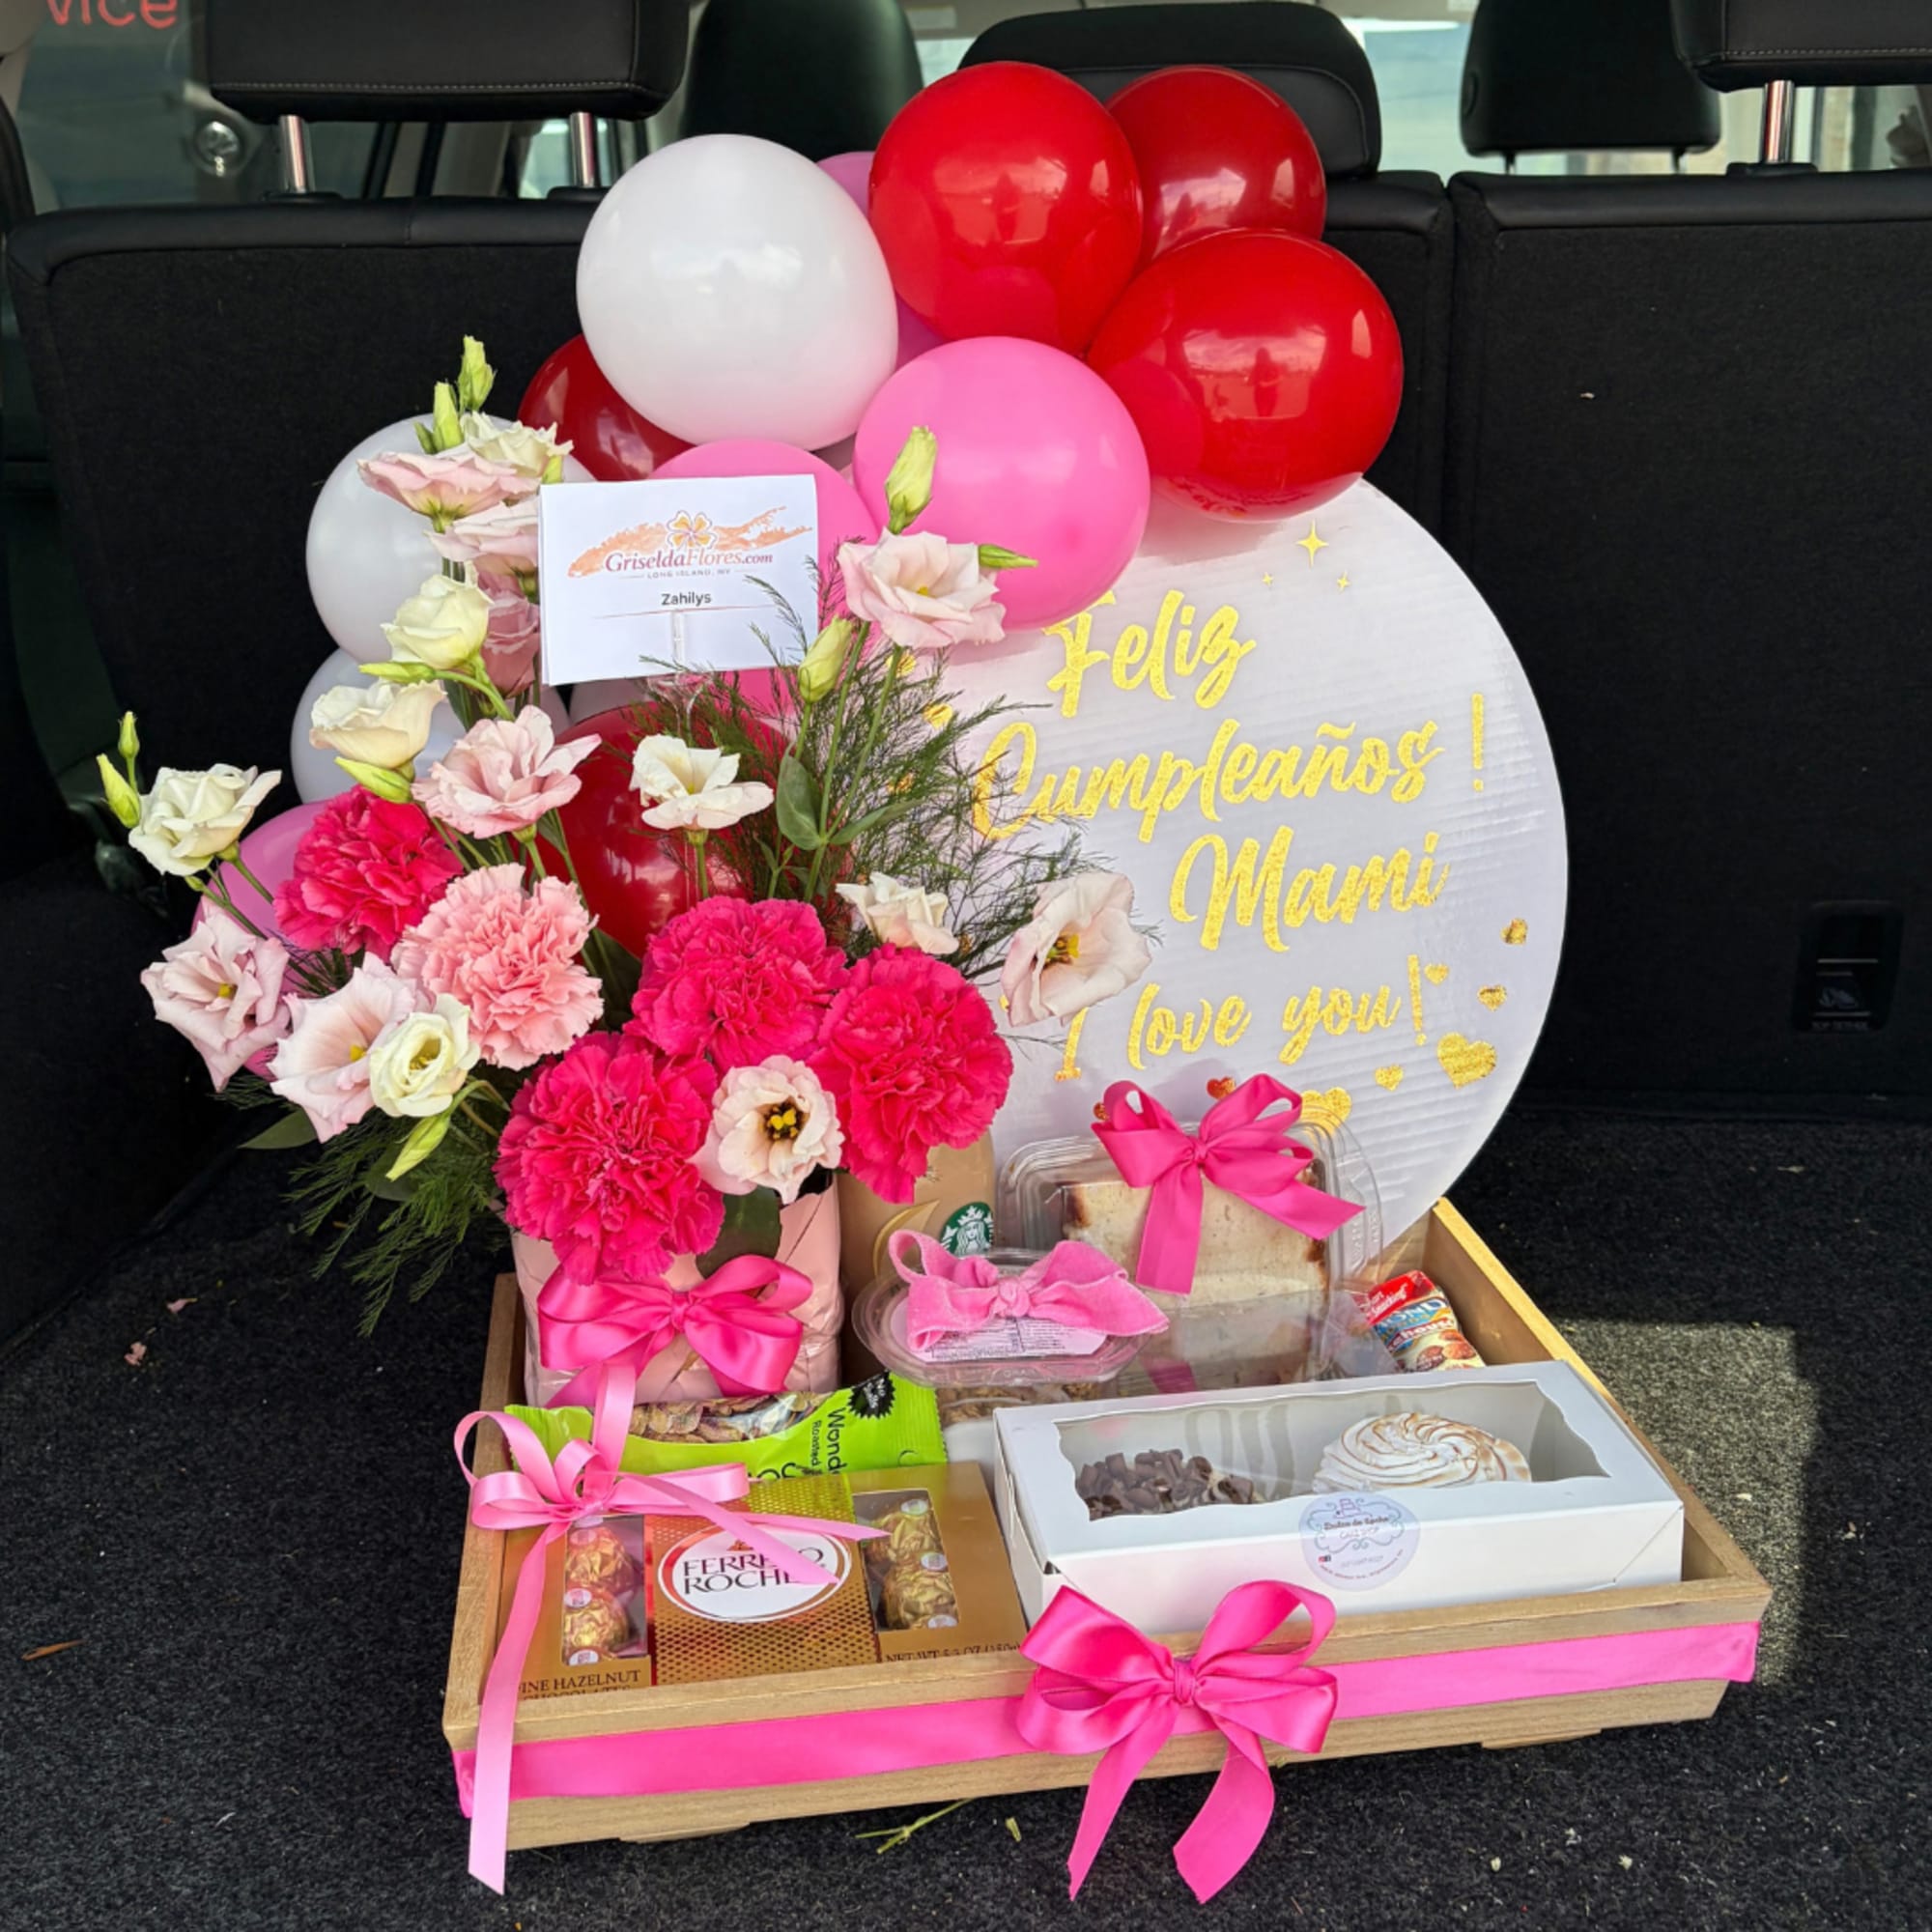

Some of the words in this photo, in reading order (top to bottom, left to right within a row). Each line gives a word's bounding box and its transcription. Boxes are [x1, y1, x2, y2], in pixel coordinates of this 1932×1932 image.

[605, 547, 773, 573] GriseldaFlores.com
[646, 571, 673, 580] LONG
[661, 591, 712, 608] Zahilys
[1041, 589, 1256, 718] Feliz
[1168, 824, 1451, 952] Mami
[1126, 981, 1252, 1070] love
[827, 1406, 848, 1474] Wond
[519, 1679, 550, 1694] INE
[553, 1669, 641, 1690] HAZELNUT
